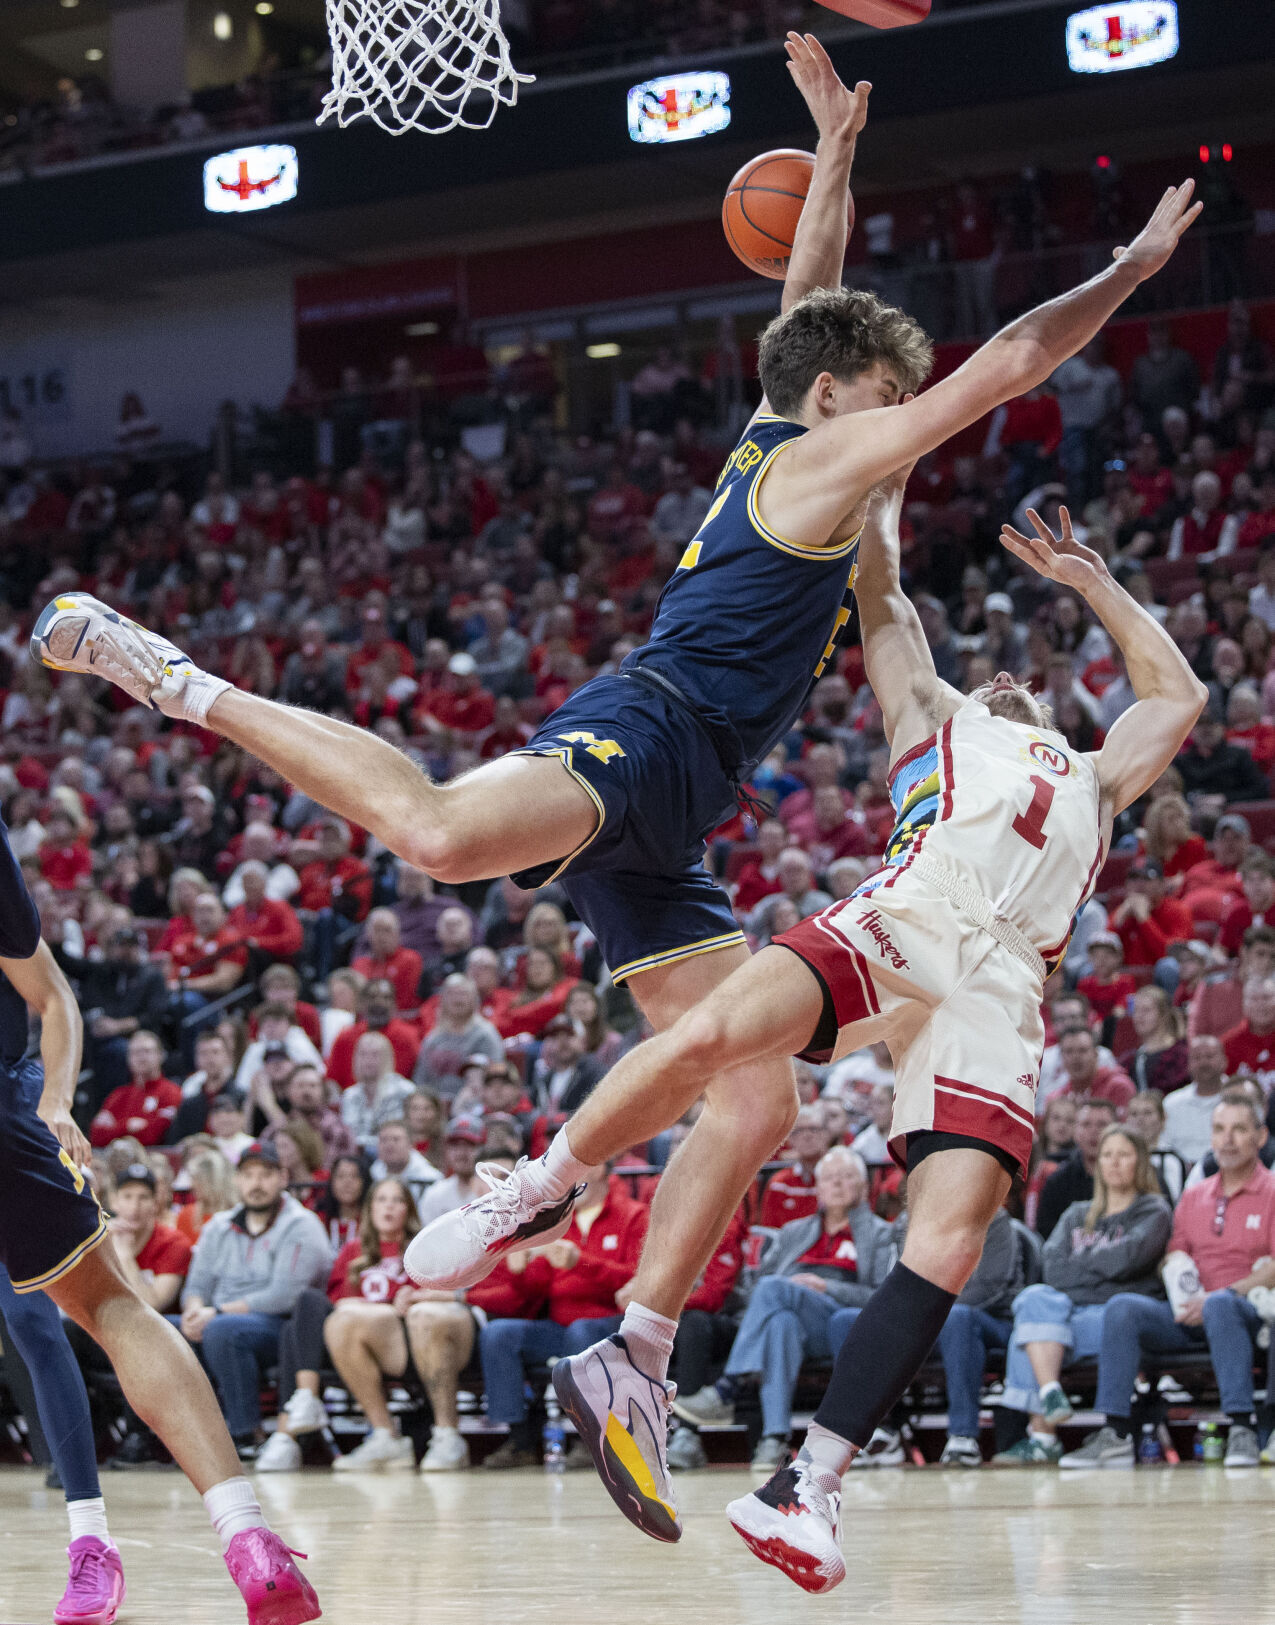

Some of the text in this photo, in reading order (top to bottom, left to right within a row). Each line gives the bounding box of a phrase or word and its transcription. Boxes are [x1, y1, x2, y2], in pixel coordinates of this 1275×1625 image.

[1042, 749, 1058, 767] N
[1011, 774, 1056, 851] 1
[855, 909, 910, 970] Huskers
